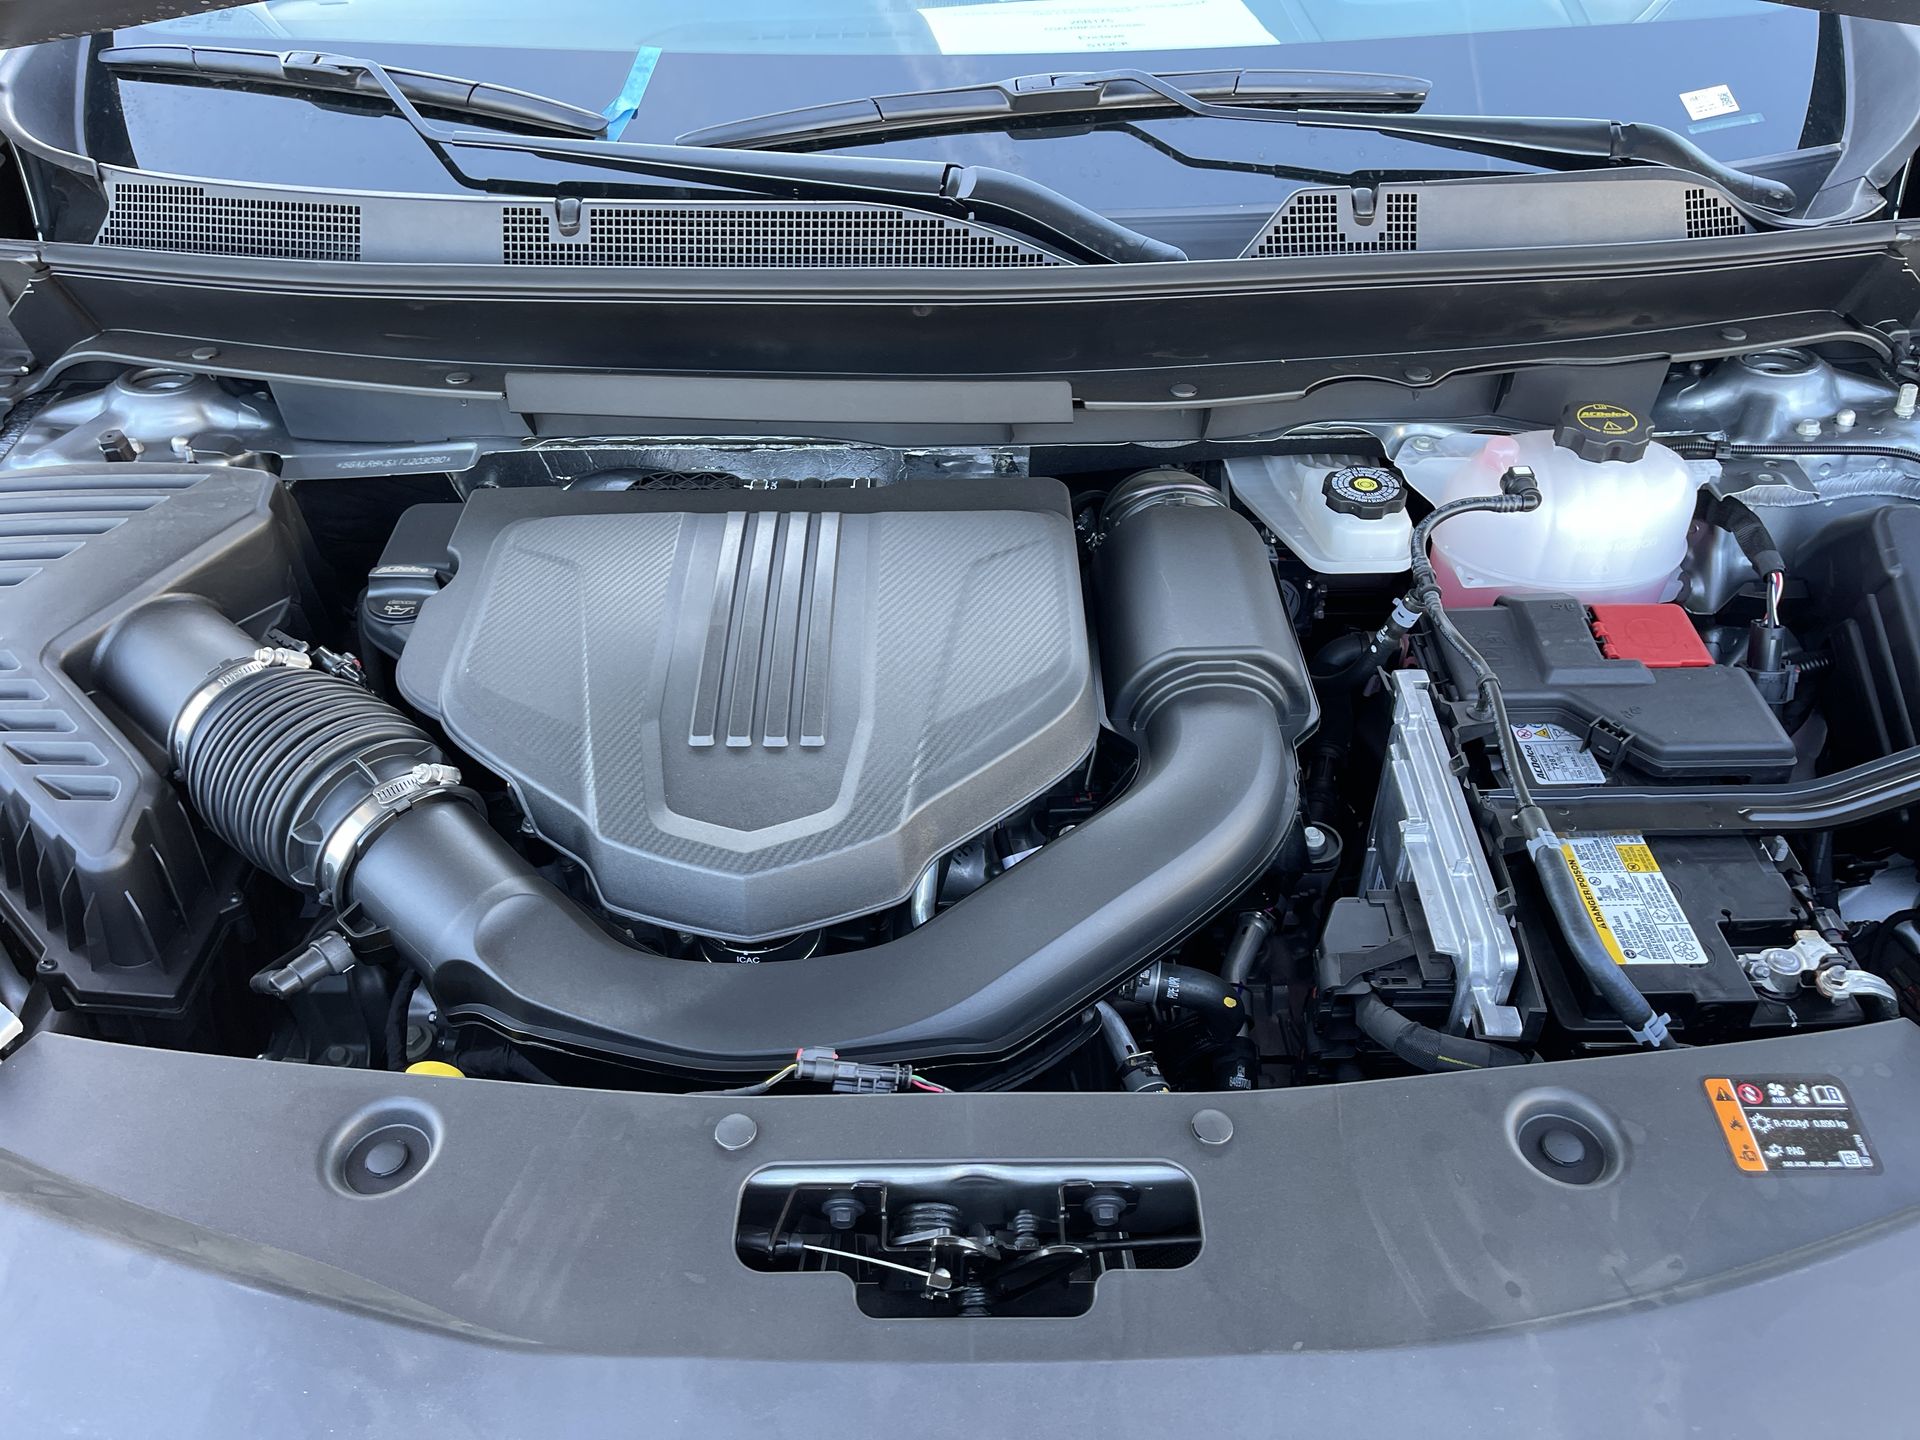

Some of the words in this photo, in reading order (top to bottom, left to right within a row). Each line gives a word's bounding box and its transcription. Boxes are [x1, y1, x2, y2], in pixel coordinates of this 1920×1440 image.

[1581, 411, 1630, 419] ACDelco
[374, 565, 430, 574] ACDelco
[1524, 744, 1546, 780] ACDelco
[1567, 859, 1606, 923] DANGER/POISON
[736, 955, 761, 965] ICAC
[1771, 1096, 1792, 1105] AUTO
[1835, 1119, 1849, 1130] kg
[1785, 1145, 1806, 1157] PAG
